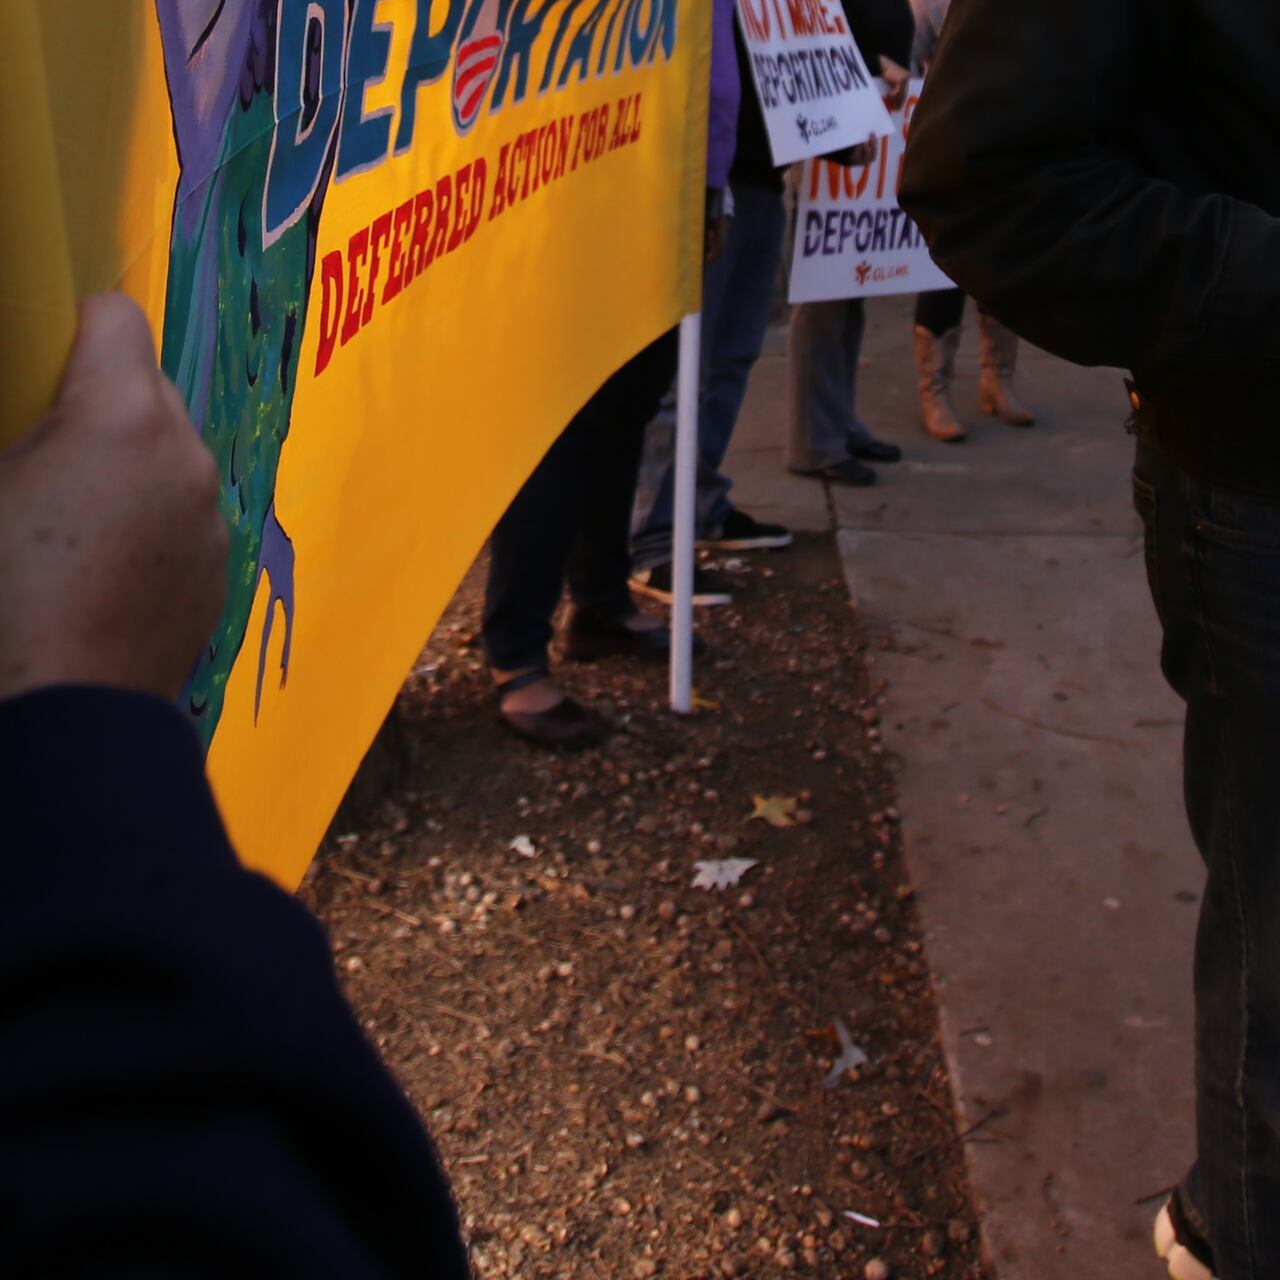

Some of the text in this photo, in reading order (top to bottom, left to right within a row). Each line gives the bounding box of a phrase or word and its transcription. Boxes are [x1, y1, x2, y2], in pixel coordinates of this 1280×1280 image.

[752, 44, 868, 109] DEPORTATION
[313, 92, 642, 379] DEFERRED ACTION FOR ALL
